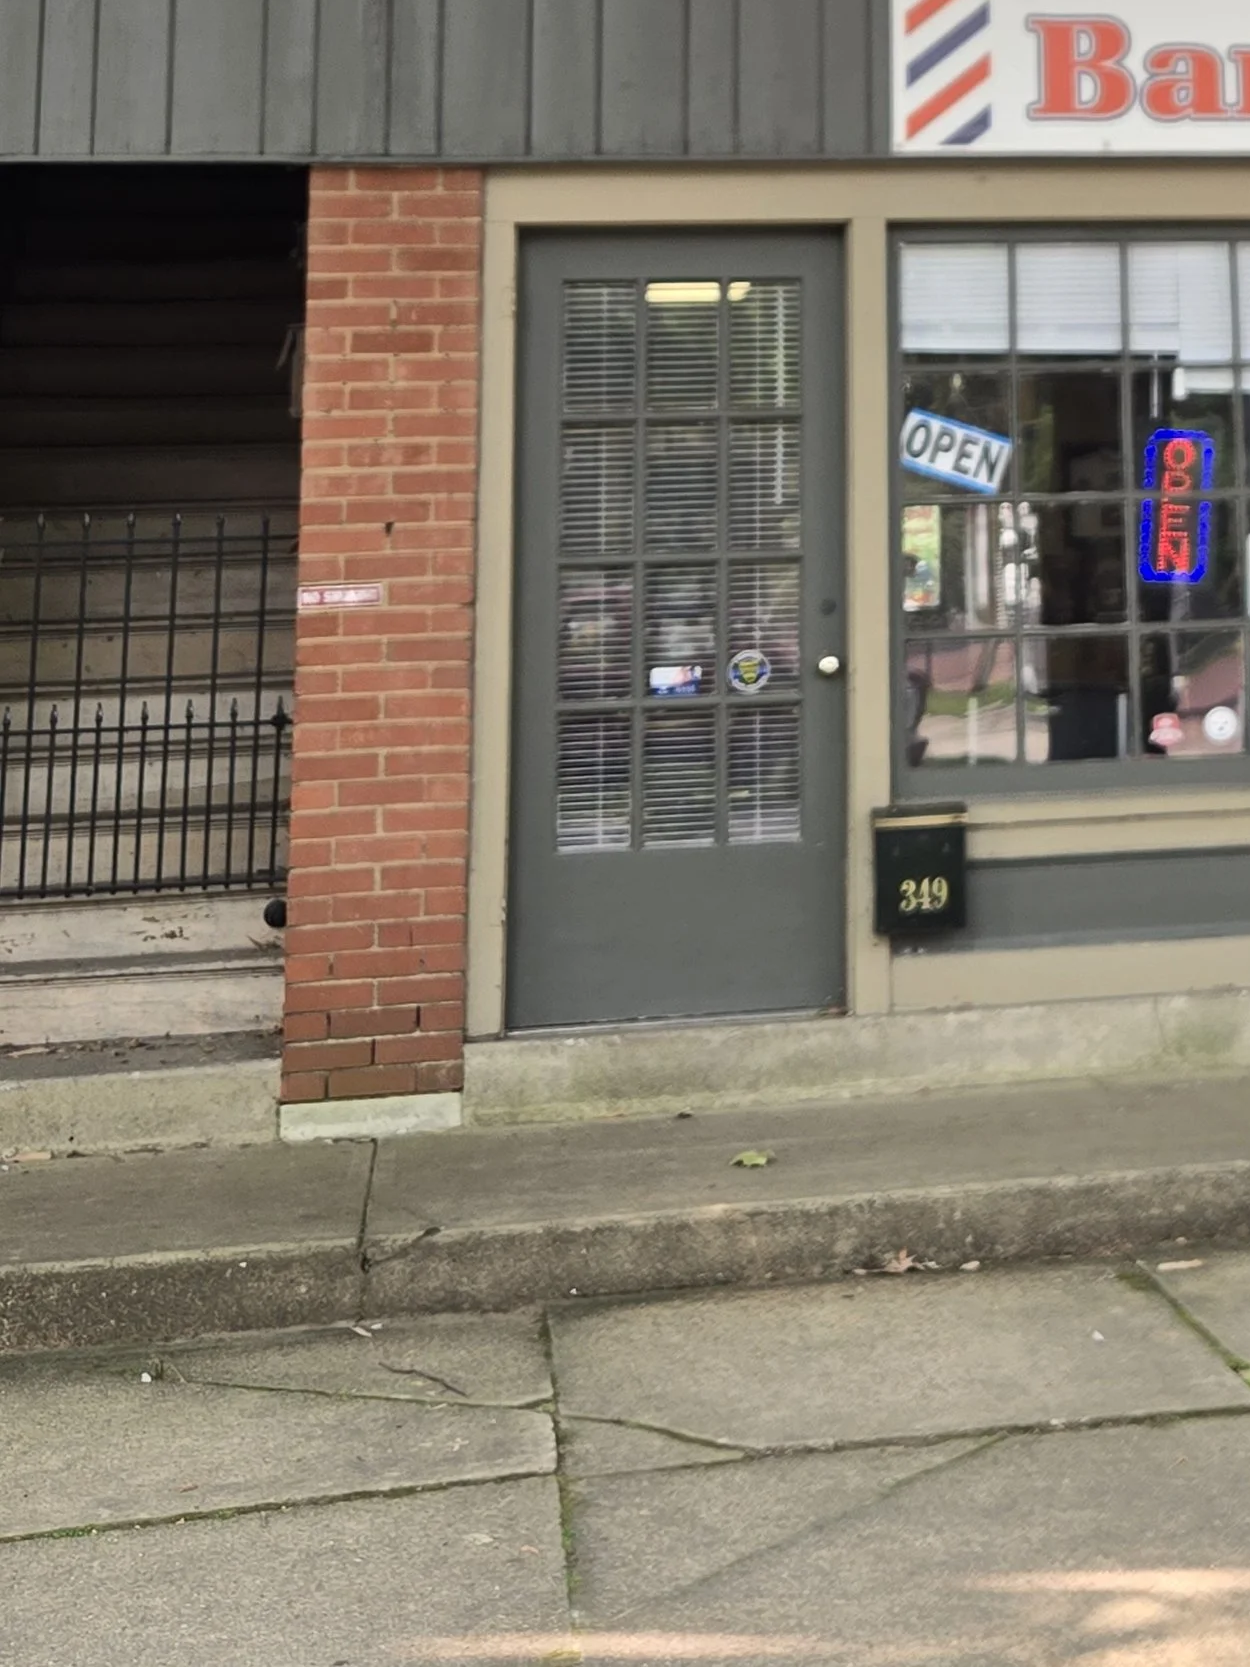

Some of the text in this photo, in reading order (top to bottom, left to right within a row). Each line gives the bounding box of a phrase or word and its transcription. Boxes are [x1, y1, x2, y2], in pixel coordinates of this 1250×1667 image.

[905, 418, 1004, 483] OPEN
[1156, 438, 1196, 572] OPEN
[899, 877, 948, 911] 349
